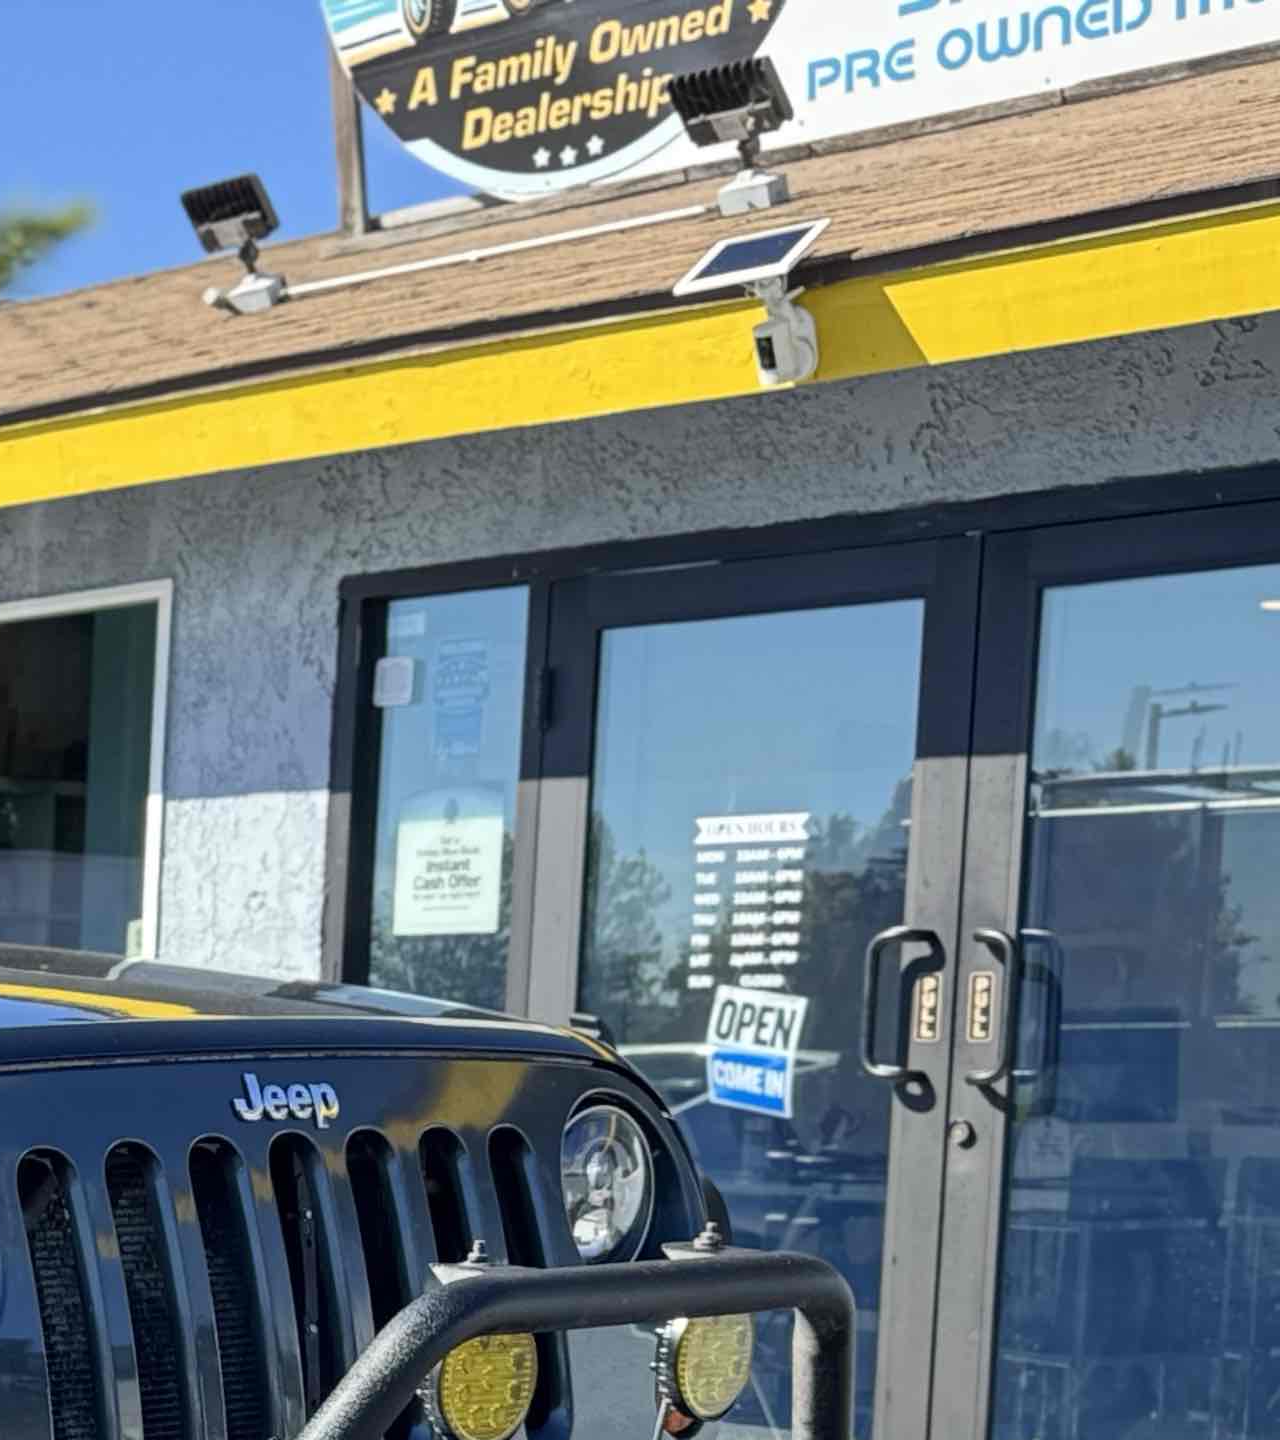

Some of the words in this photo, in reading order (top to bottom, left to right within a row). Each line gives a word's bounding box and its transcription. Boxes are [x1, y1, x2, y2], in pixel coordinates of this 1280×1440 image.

[407, 66, 438, 110] A
[449, 35, 578, 100] Family
[589, 0, 732, 64] Owned
[807, 38, 915, 101] PRE
[936, 0, 1151, 71] OWNED
[462, 66, 675, 150] Dealership
[412, 875, 444, 891] Cash
[447, 872, 482, 889] Offer
[715, 999, 797, 1051] OPEN
[920, 975, 938, 1038] PULL
[972, 975, 991, 1038] PULL
[232, 1072, 339, 1128] Jeep
[712, 1059, 765, 1095] COME
[765, 1066, 785, 1099] IN
